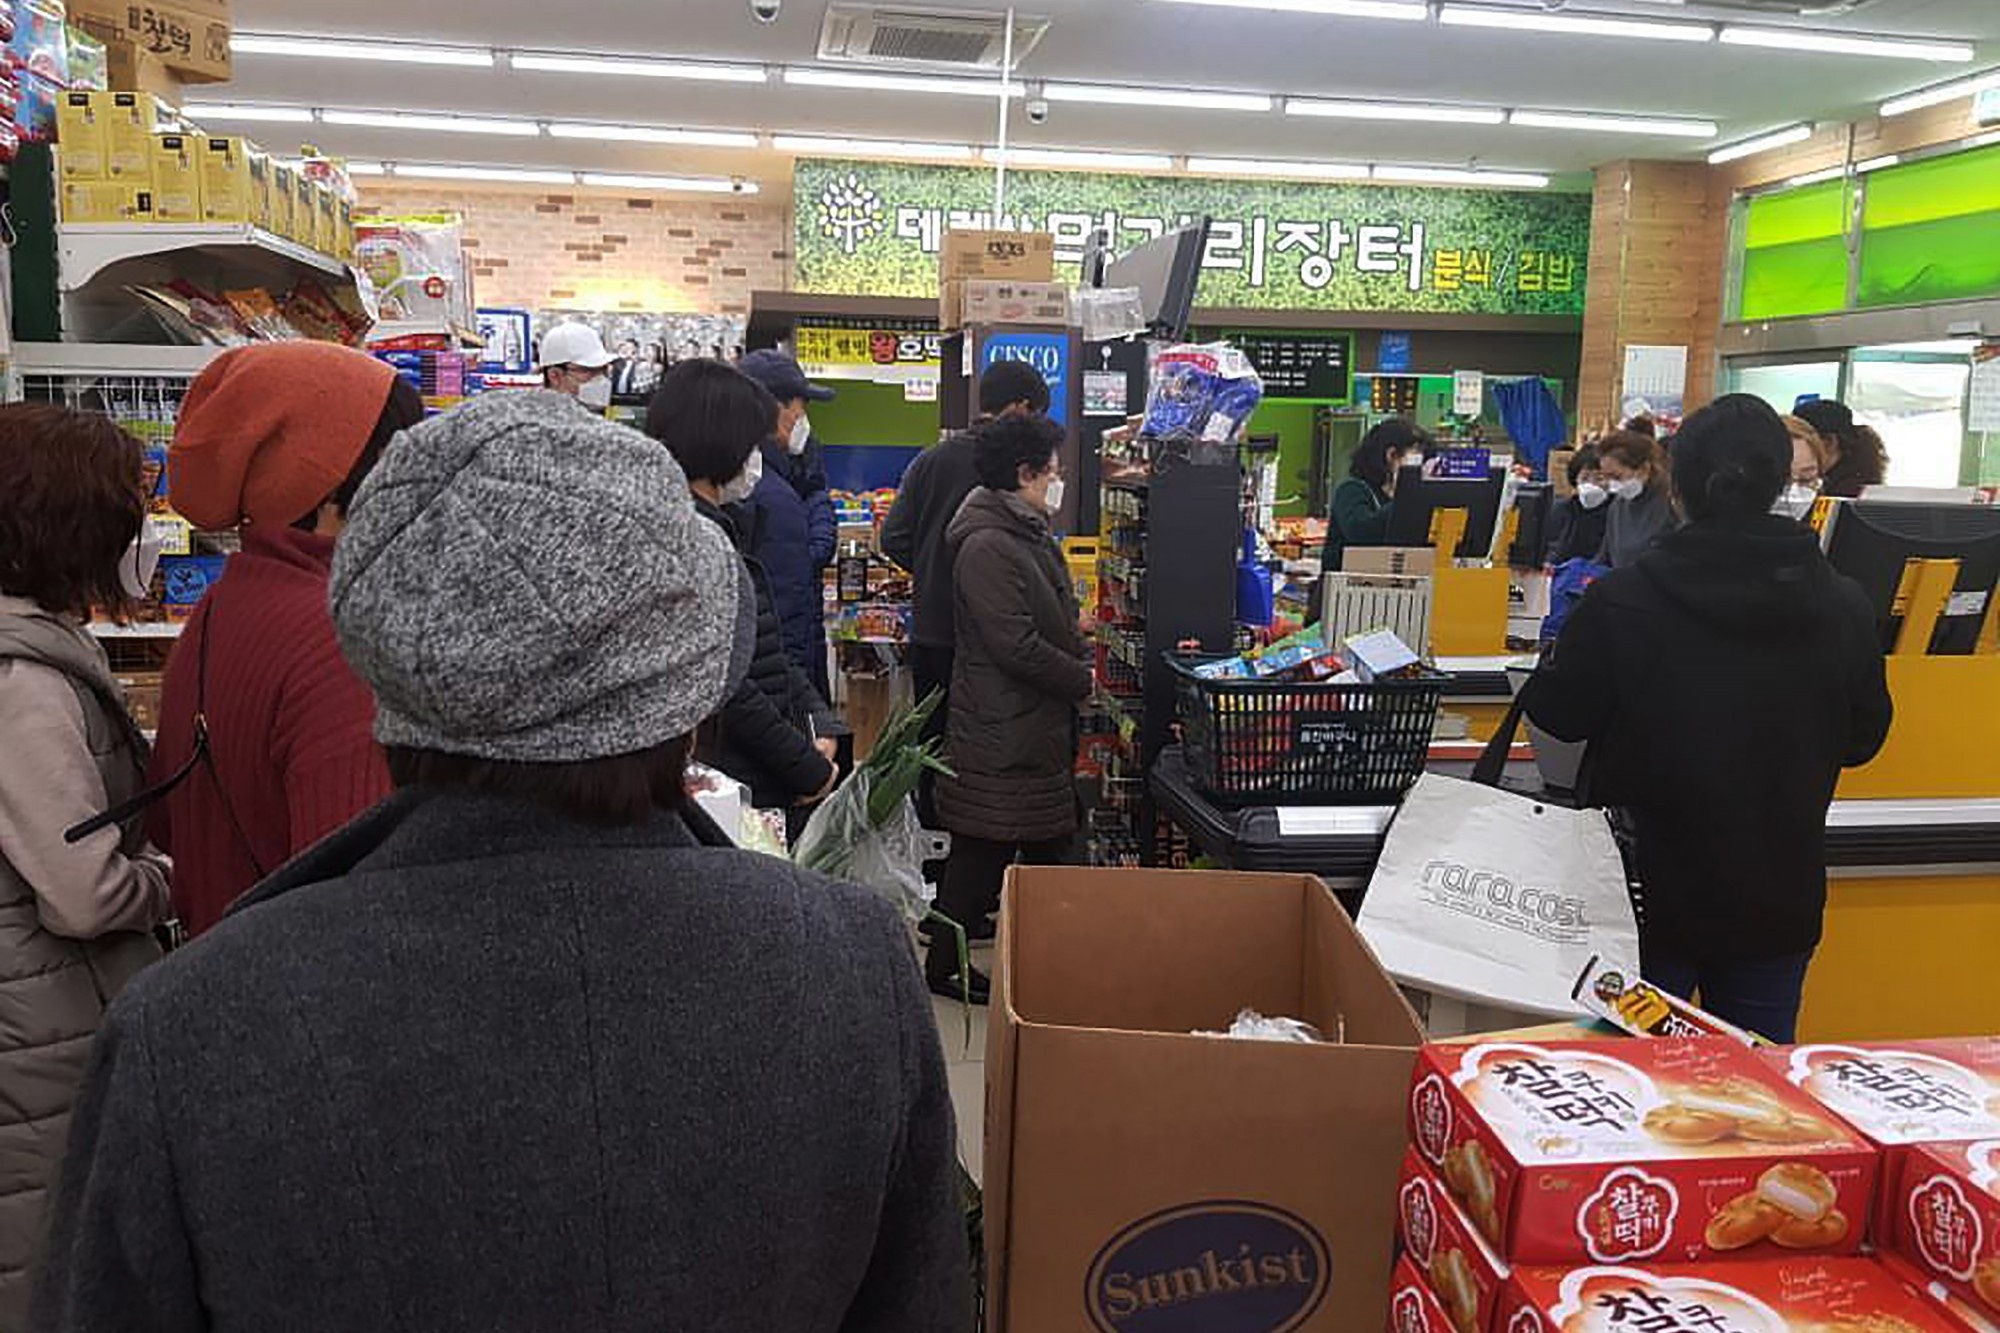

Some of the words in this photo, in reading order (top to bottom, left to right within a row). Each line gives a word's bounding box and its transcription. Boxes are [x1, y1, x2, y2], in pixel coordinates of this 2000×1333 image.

[1047, 210, 1426, 291] 먹리장터
[1433, 248, 1493, 291] 분식
[1516, 251, 1575, 292] 김밥
[1611, 1182, 1645, 1248] 찰떡
[1104, 1243, 1312, 1317] Sunkist
